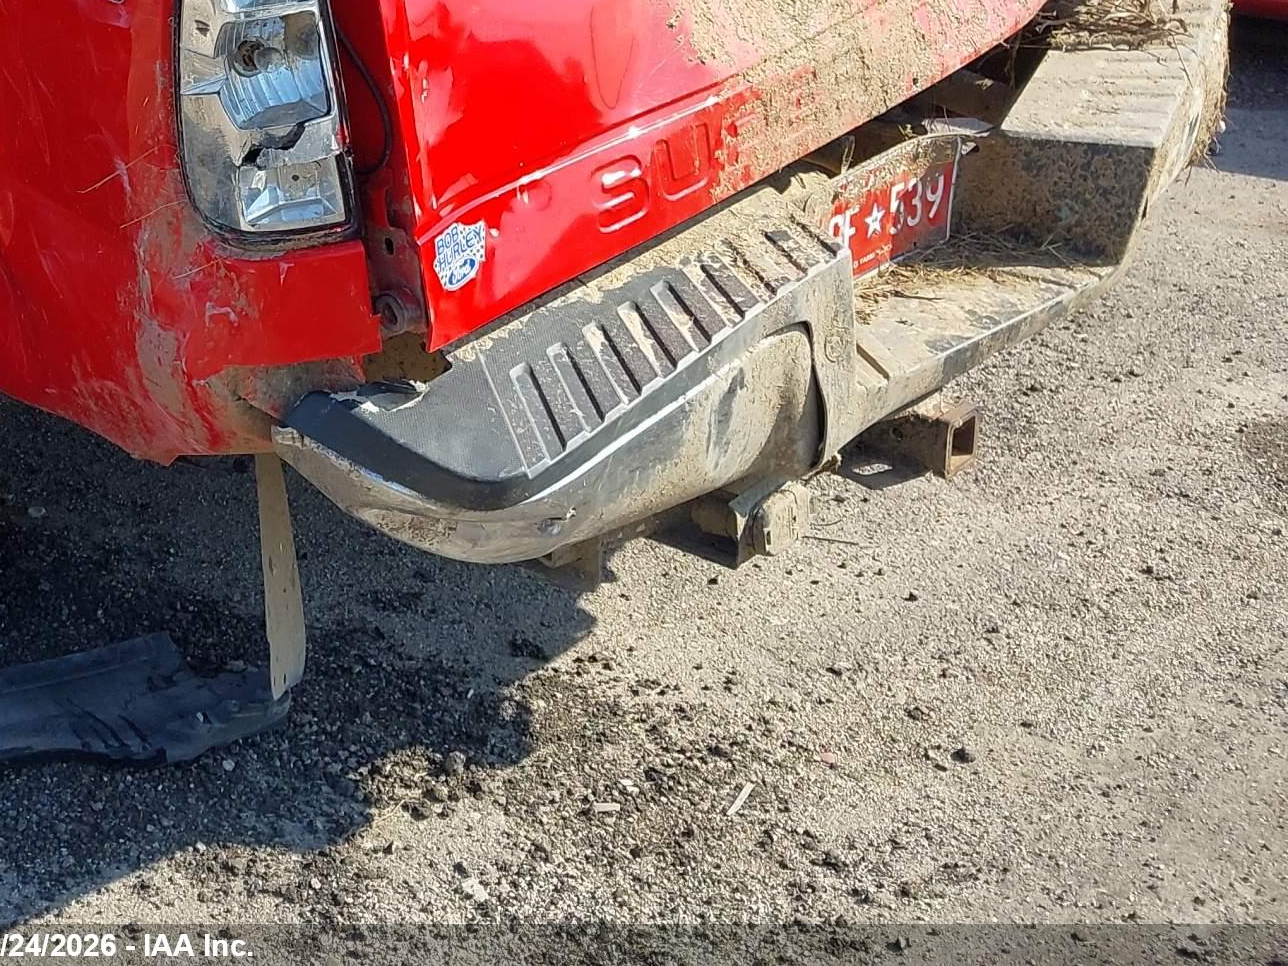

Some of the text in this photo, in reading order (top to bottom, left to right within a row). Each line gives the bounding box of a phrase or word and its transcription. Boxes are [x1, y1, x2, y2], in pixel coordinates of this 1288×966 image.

[889, 173, 944, 235] 539
[437, 225, 460, 255] BOB
[438, 224, 483, 272] HURLEY
